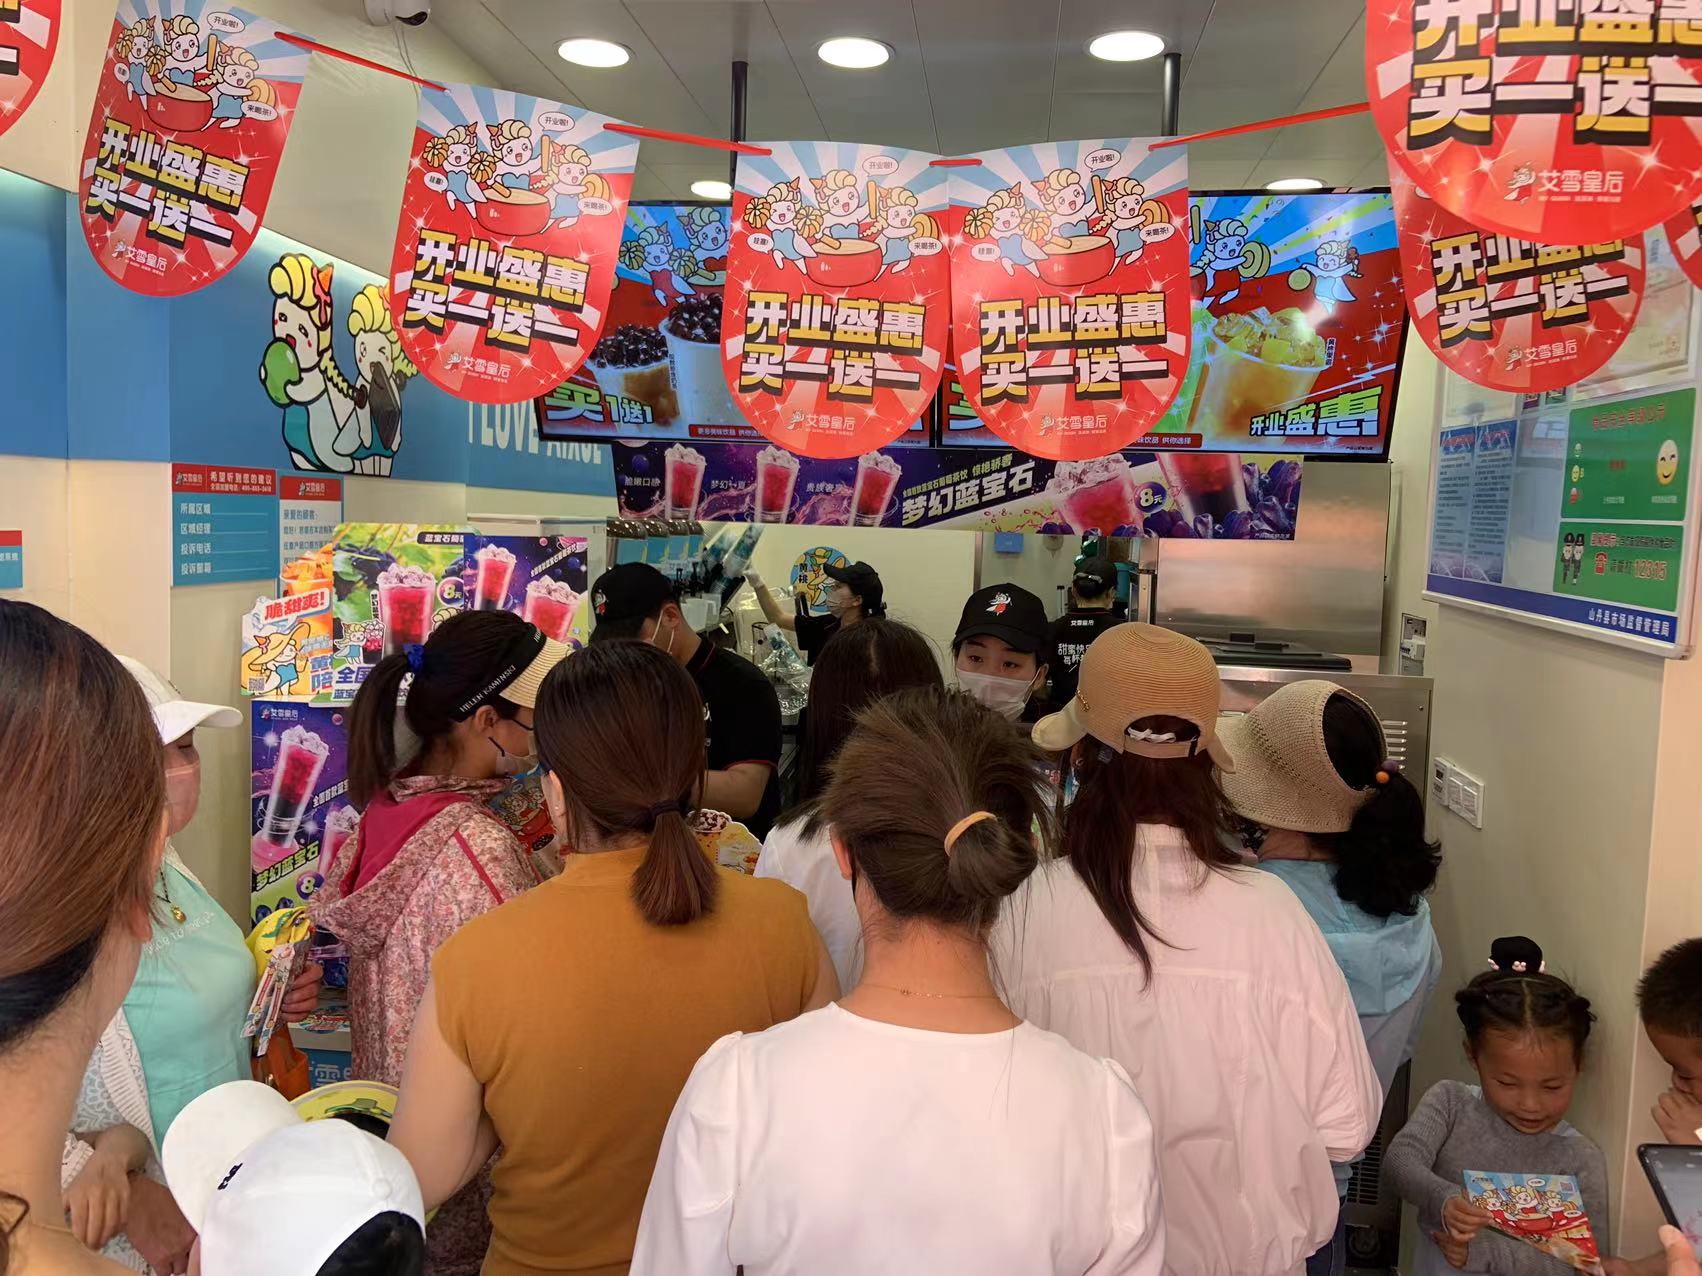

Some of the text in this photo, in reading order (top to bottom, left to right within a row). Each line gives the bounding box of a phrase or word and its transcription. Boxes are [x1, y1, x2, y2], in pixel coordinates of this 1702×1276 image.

[99, 118, 249, 210] 开业盛惠
[1538, 170, 1624, 194] 艾雪皇后
[87, 168, 233, 245] 买一送一
[126, 249, 167, 270] 艾雪皇后
[414, 228, 590, 309] 开业盛惠
[404, 281, 579, 350] 买一送一
[745, 291, 926, 353] 开业盛惠
[980, 291, 1167, 350] 开业盛惠
[1437, 269, 1629, 346] 买一送一
[463, 356, 511, 378] 艾雪皇后
[740, 342, 920, 400] 买一送一
[981, 347, 1168, 402] 买一送一
[1526, 339, 1577, 362] 艾雪皇后
[545, 382, 654, 424] 买1送1
[806, 414, 855, 429] 艾雪皇后
[1055, 415, 1108, 429] 艾雪皇后
[1250, 385, 1382, 437] 开业盛惠
[902, 460, 1035, 526] 梦幻蓝宝石
[1138, 486, 1163, 506] 8元
[180, 542, 212, 555] 投诉电话
[265, 592, 324, 619] 脆甜爽!
[1588, 607, 1670, 637] 山丹县市场监督管理局
[460, 664, 516, 713] HELEN KAMINSKI
[255, 841, 320, 892] 梦幻蓝宝石
